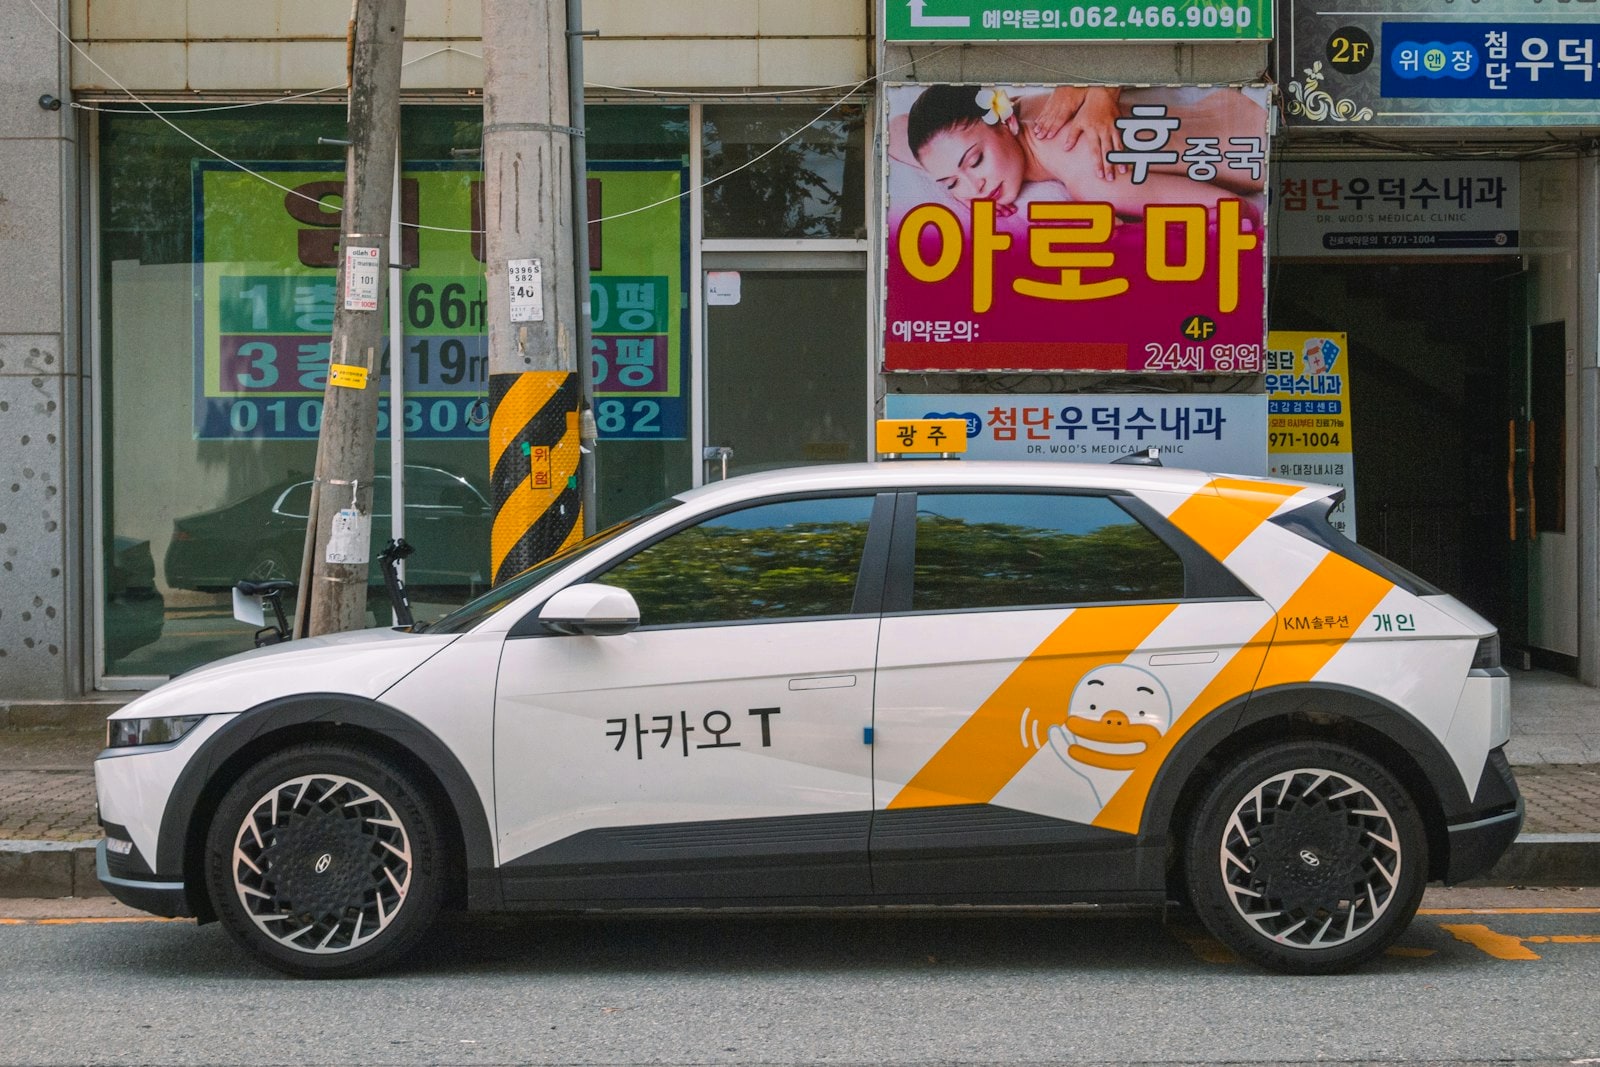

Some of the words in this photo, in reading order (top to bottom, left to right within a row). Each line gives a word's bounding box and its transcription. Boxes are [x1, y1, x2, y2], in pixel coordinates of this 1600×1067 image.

[1332, 37, 1369, 63] 2F
[1515, 37, 1600, 82] 우덕
[1280, 176, 1507, 211] 첨단우덕수내과
[1317, 214, 1333, 223] DR.
[1379, 213, 1426, 223] MEDICAL
[1430, 213, 1467, 222] CLINIC
[899, 198, 1257, 314] 아로마
[360, 276, 374, 285] 101
[1184, 316, 1215, 339] 4F
[1144, 342, 1204, 371] 24시
[1210, 344, 1260, 371] 영업
[1265, 374, 1342, 395] 우덕수내과
[987, 406, 1226, 441] 첨단우덕수내과
[1027, 445, 1046, 454] DR.
[1050, 444, 1087, 454] WOO'S
[1269, 432, 1340, 447] 971-1004
[1283, 615, 1350, 630] KM솔루션
[1372, 613, 1416, 632] 개인
[606, 709, 741, 760] 카카오
[748, 707, 781, 748] T
